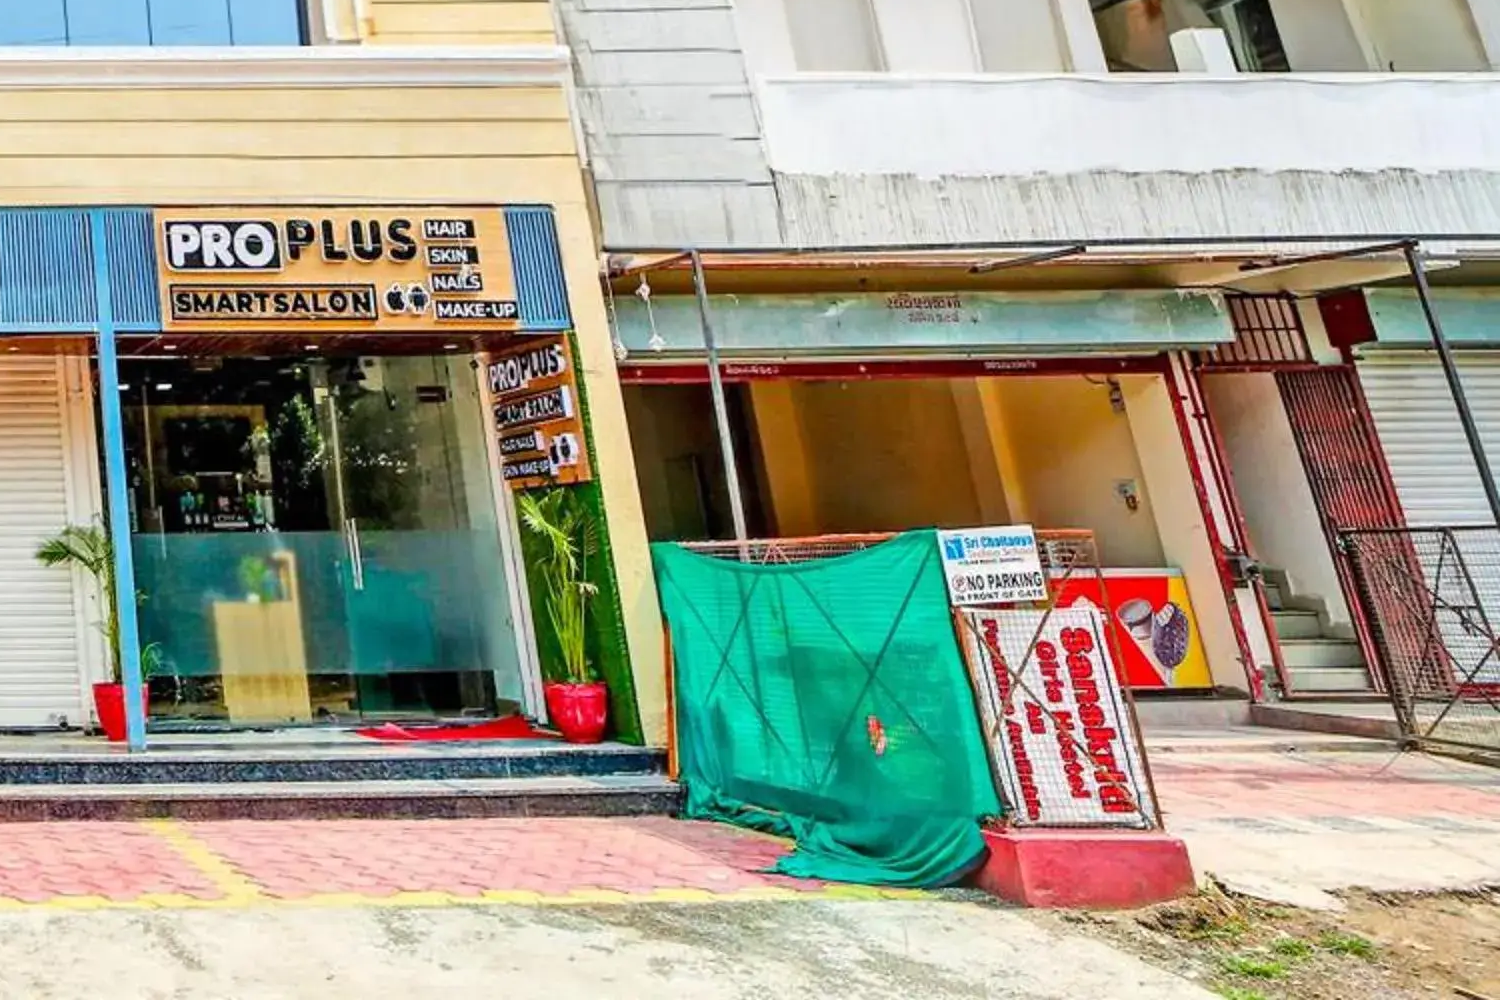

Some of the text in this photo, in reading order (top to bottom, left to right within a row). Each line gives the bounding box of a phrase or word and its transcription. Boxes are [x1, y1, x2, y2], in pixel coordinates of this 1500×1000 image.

[426, 221, 467, 238] HAIR
[168, 219, 417, 267] PRO PLUS
[429, 249, 469, 264] SKIN
[433, 275, 481, 291] NAILS
[437, 302, 516, 318] MAKE-UP
[489, 347, 562, 391] PRO PLUS
[964, 537, 978, 549] Sri
[966, 571, 1043, 591] NO PARKING
[967, 592, 999, 601] FRONT
[1002, 591, 1014, 599] OF
[1018, 588, 1044, 598] GATE
[1035, 640, 1092, 798] Girls Hostel
[1060, 626, 1137, 813] Sanskriti
